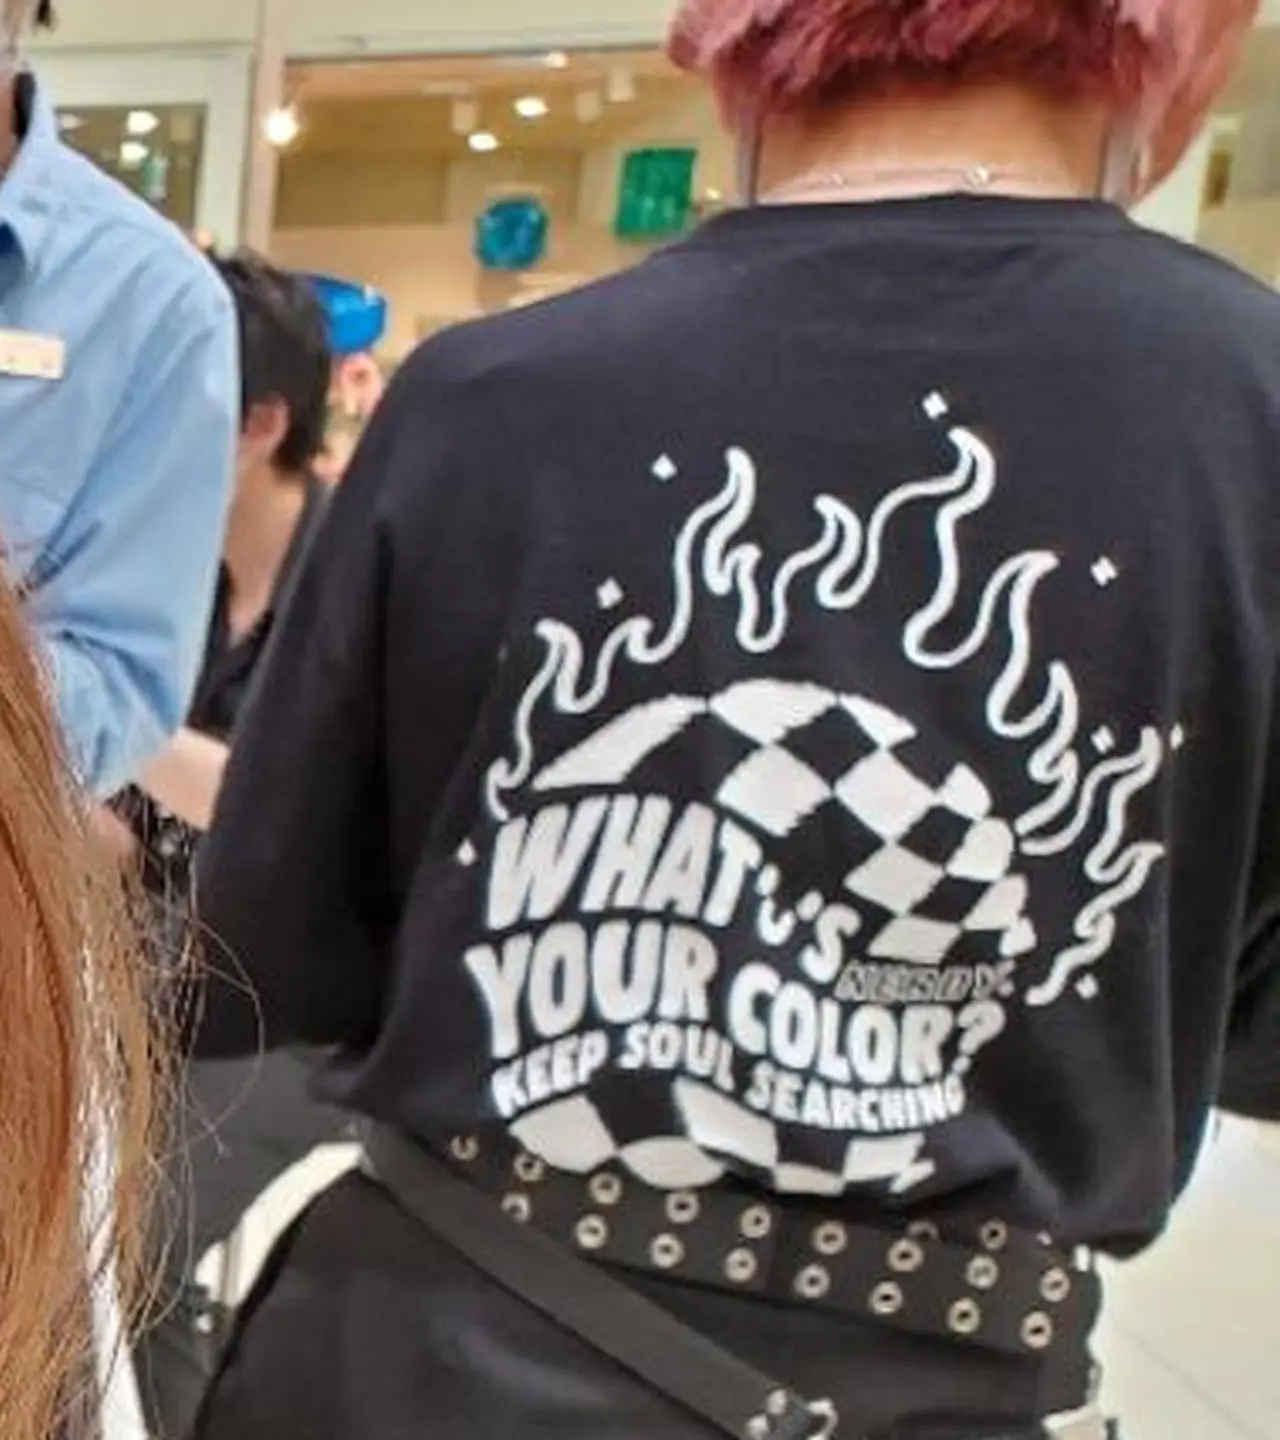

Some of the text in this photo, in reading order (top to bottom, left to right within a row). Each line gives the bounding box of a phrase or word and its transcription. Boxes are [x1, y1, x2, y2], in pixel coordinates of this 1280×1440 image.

[464, 918, 1007, 1084] YOUR COLOR?
[491, 1021, 966, 1131] KEEP SOUL SEARCHING
